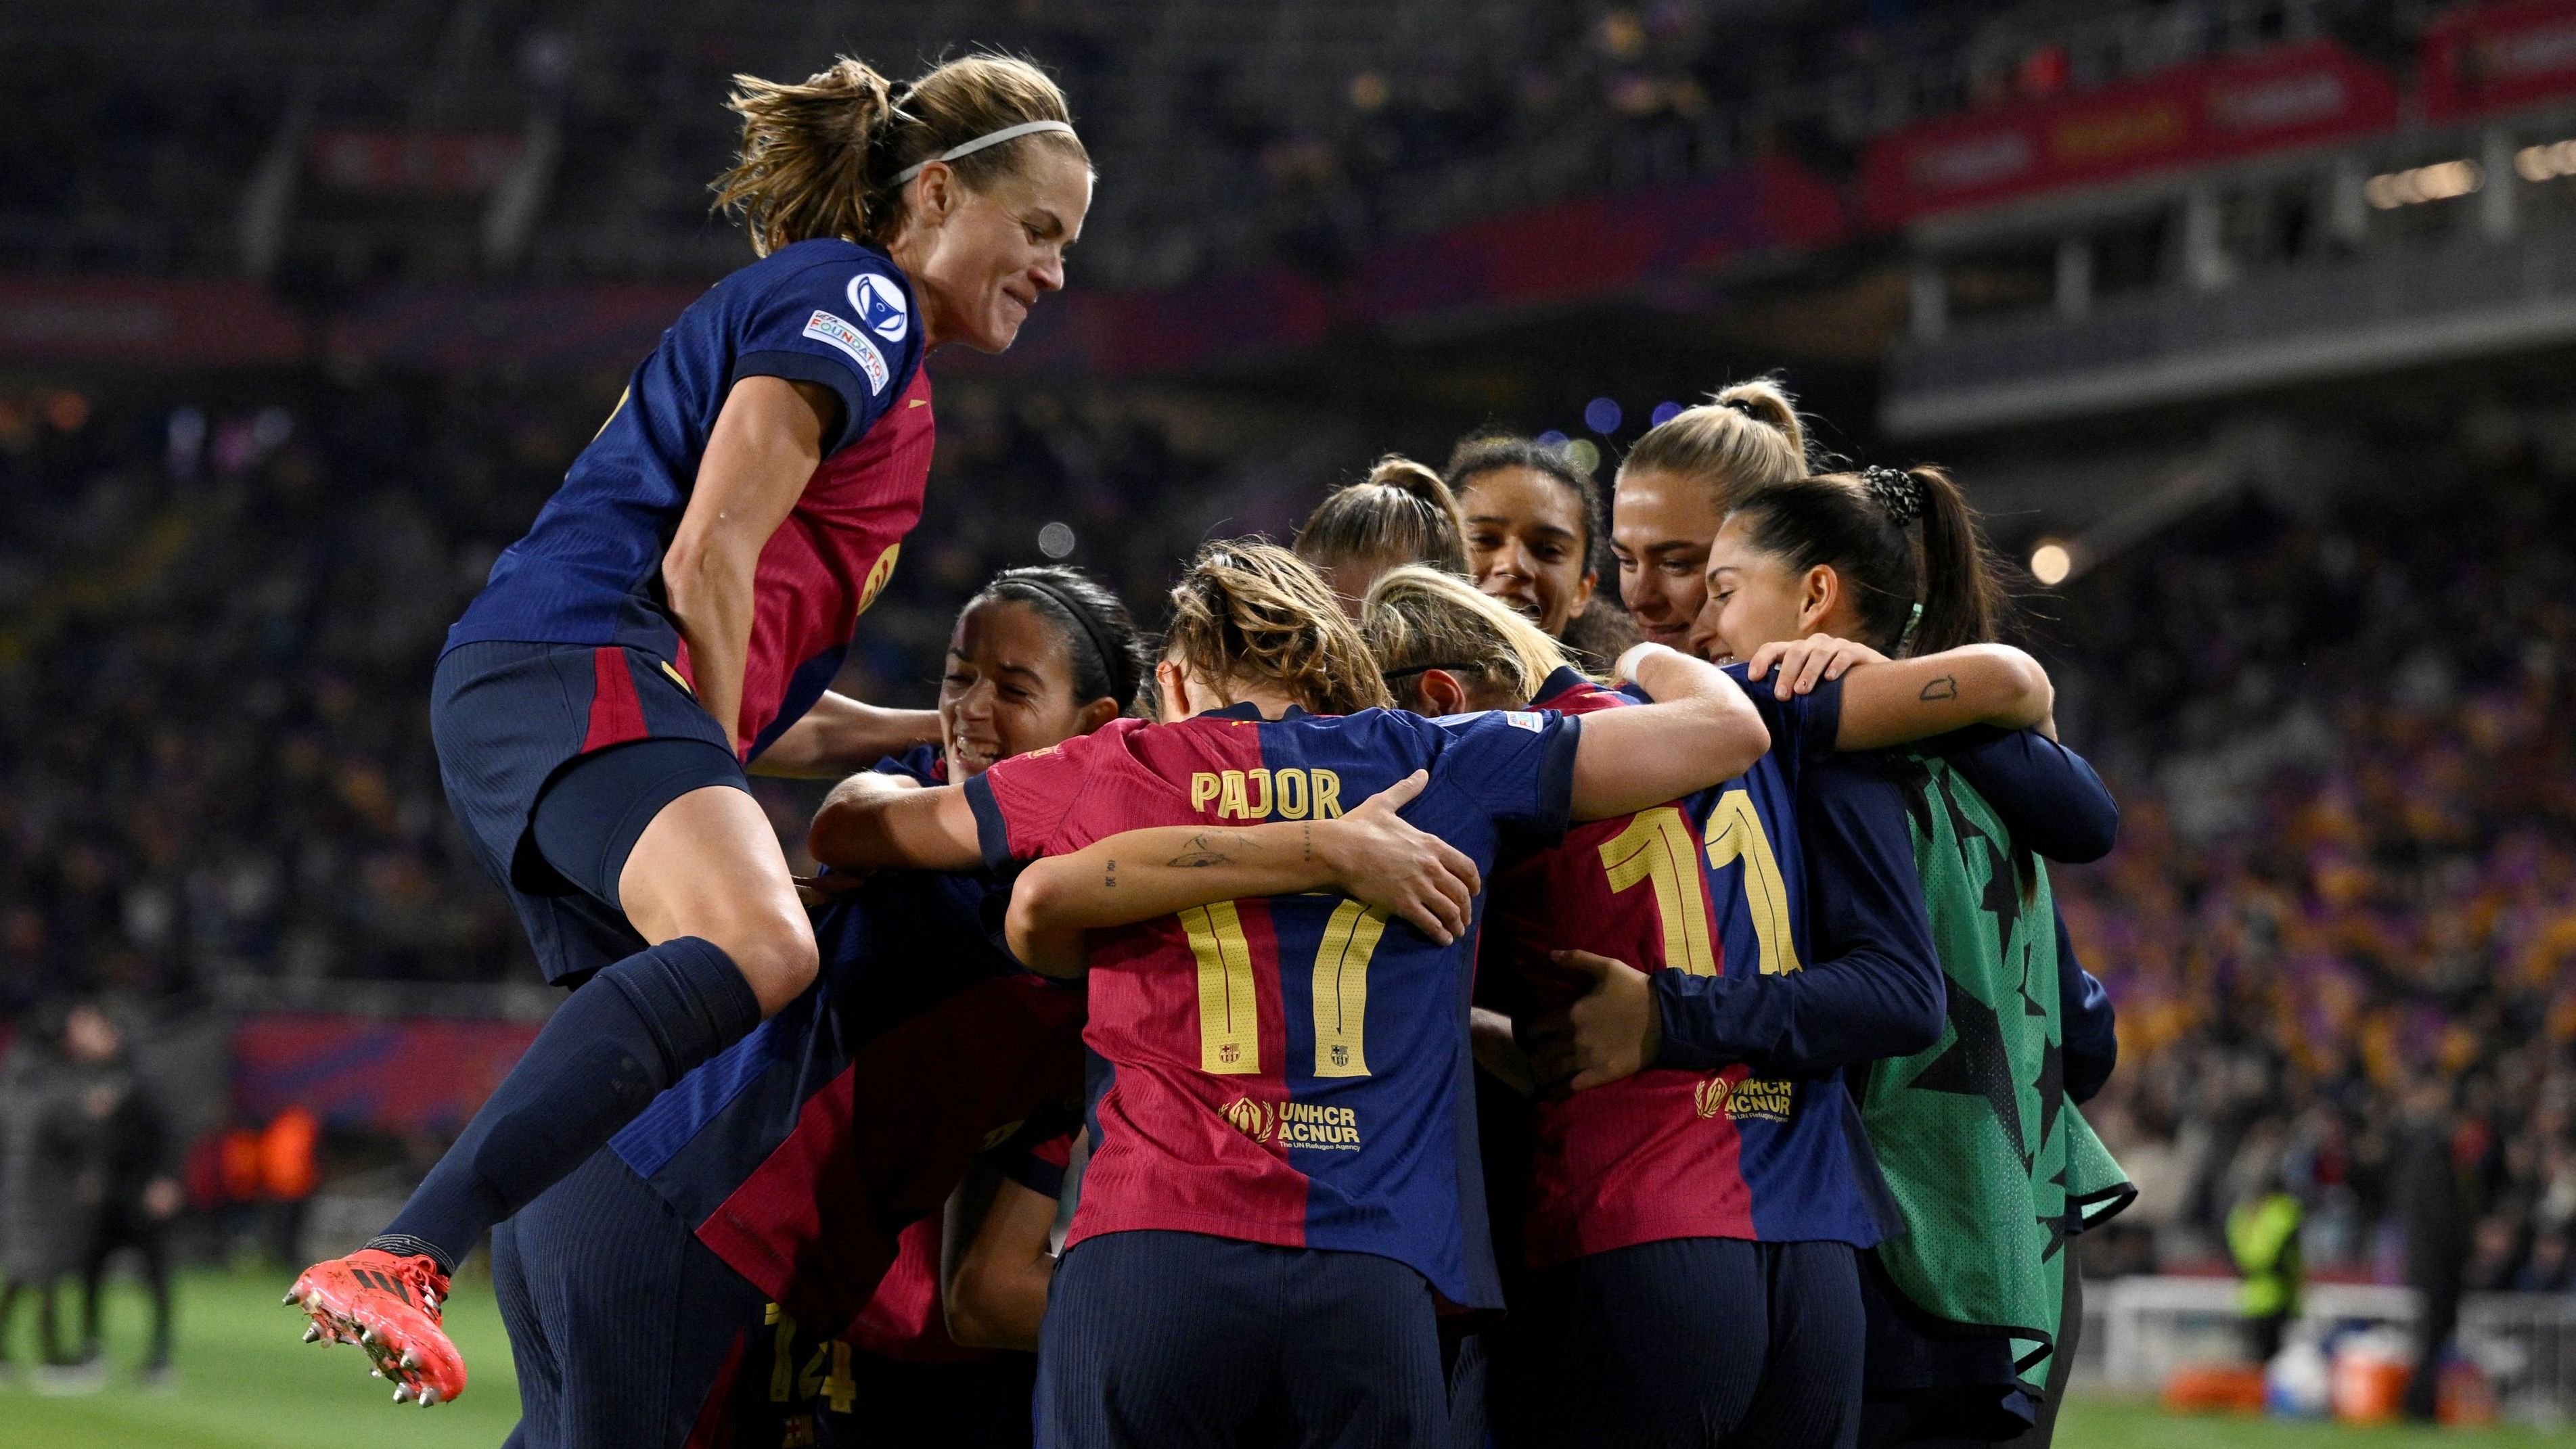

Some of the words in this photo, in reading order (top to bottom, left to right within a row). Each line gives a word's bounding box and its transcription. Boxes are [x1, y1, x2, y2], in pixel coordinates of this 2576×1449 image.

[816, 313, 838, 323] UEFA
[1191, 768, 1343, 820] PAJOR
[1598, 789, 1803, 977] 11
[1279, 1102, 1356, 1126] UNHCR
[1724, 1095, 1790, 1115] ACNUR
[1278, 1122, 1361, 1143] ACNUR
[1305, 1143, 1334, 1151] Refugee
[1335, 1144, 1361, 1152] Agency
[765, 1302, 857, 1413] 14
